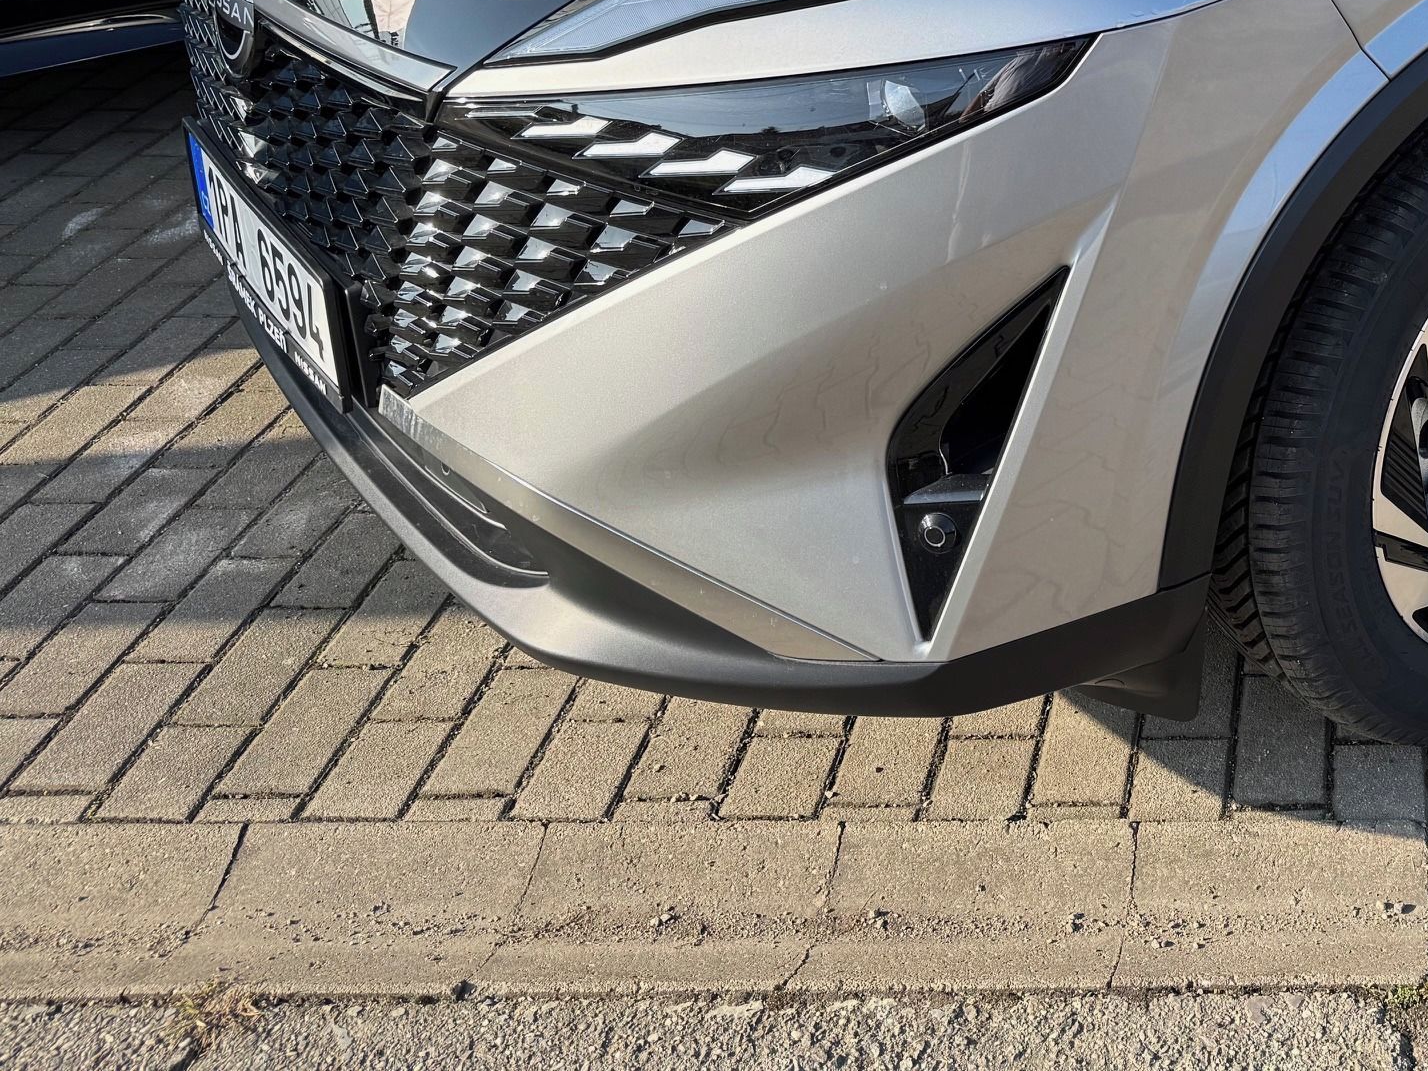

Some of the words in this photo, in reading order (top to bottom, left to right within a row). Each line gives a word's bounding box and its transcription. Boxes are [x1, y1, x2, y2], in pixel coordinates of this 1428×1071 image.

[208, 166, 247, 270] 1PA
[257, 228, 325, 364] 6594
[258, 307, 288, 354] PLZEŇ
[294, 351, 327, 396] NISSAN
